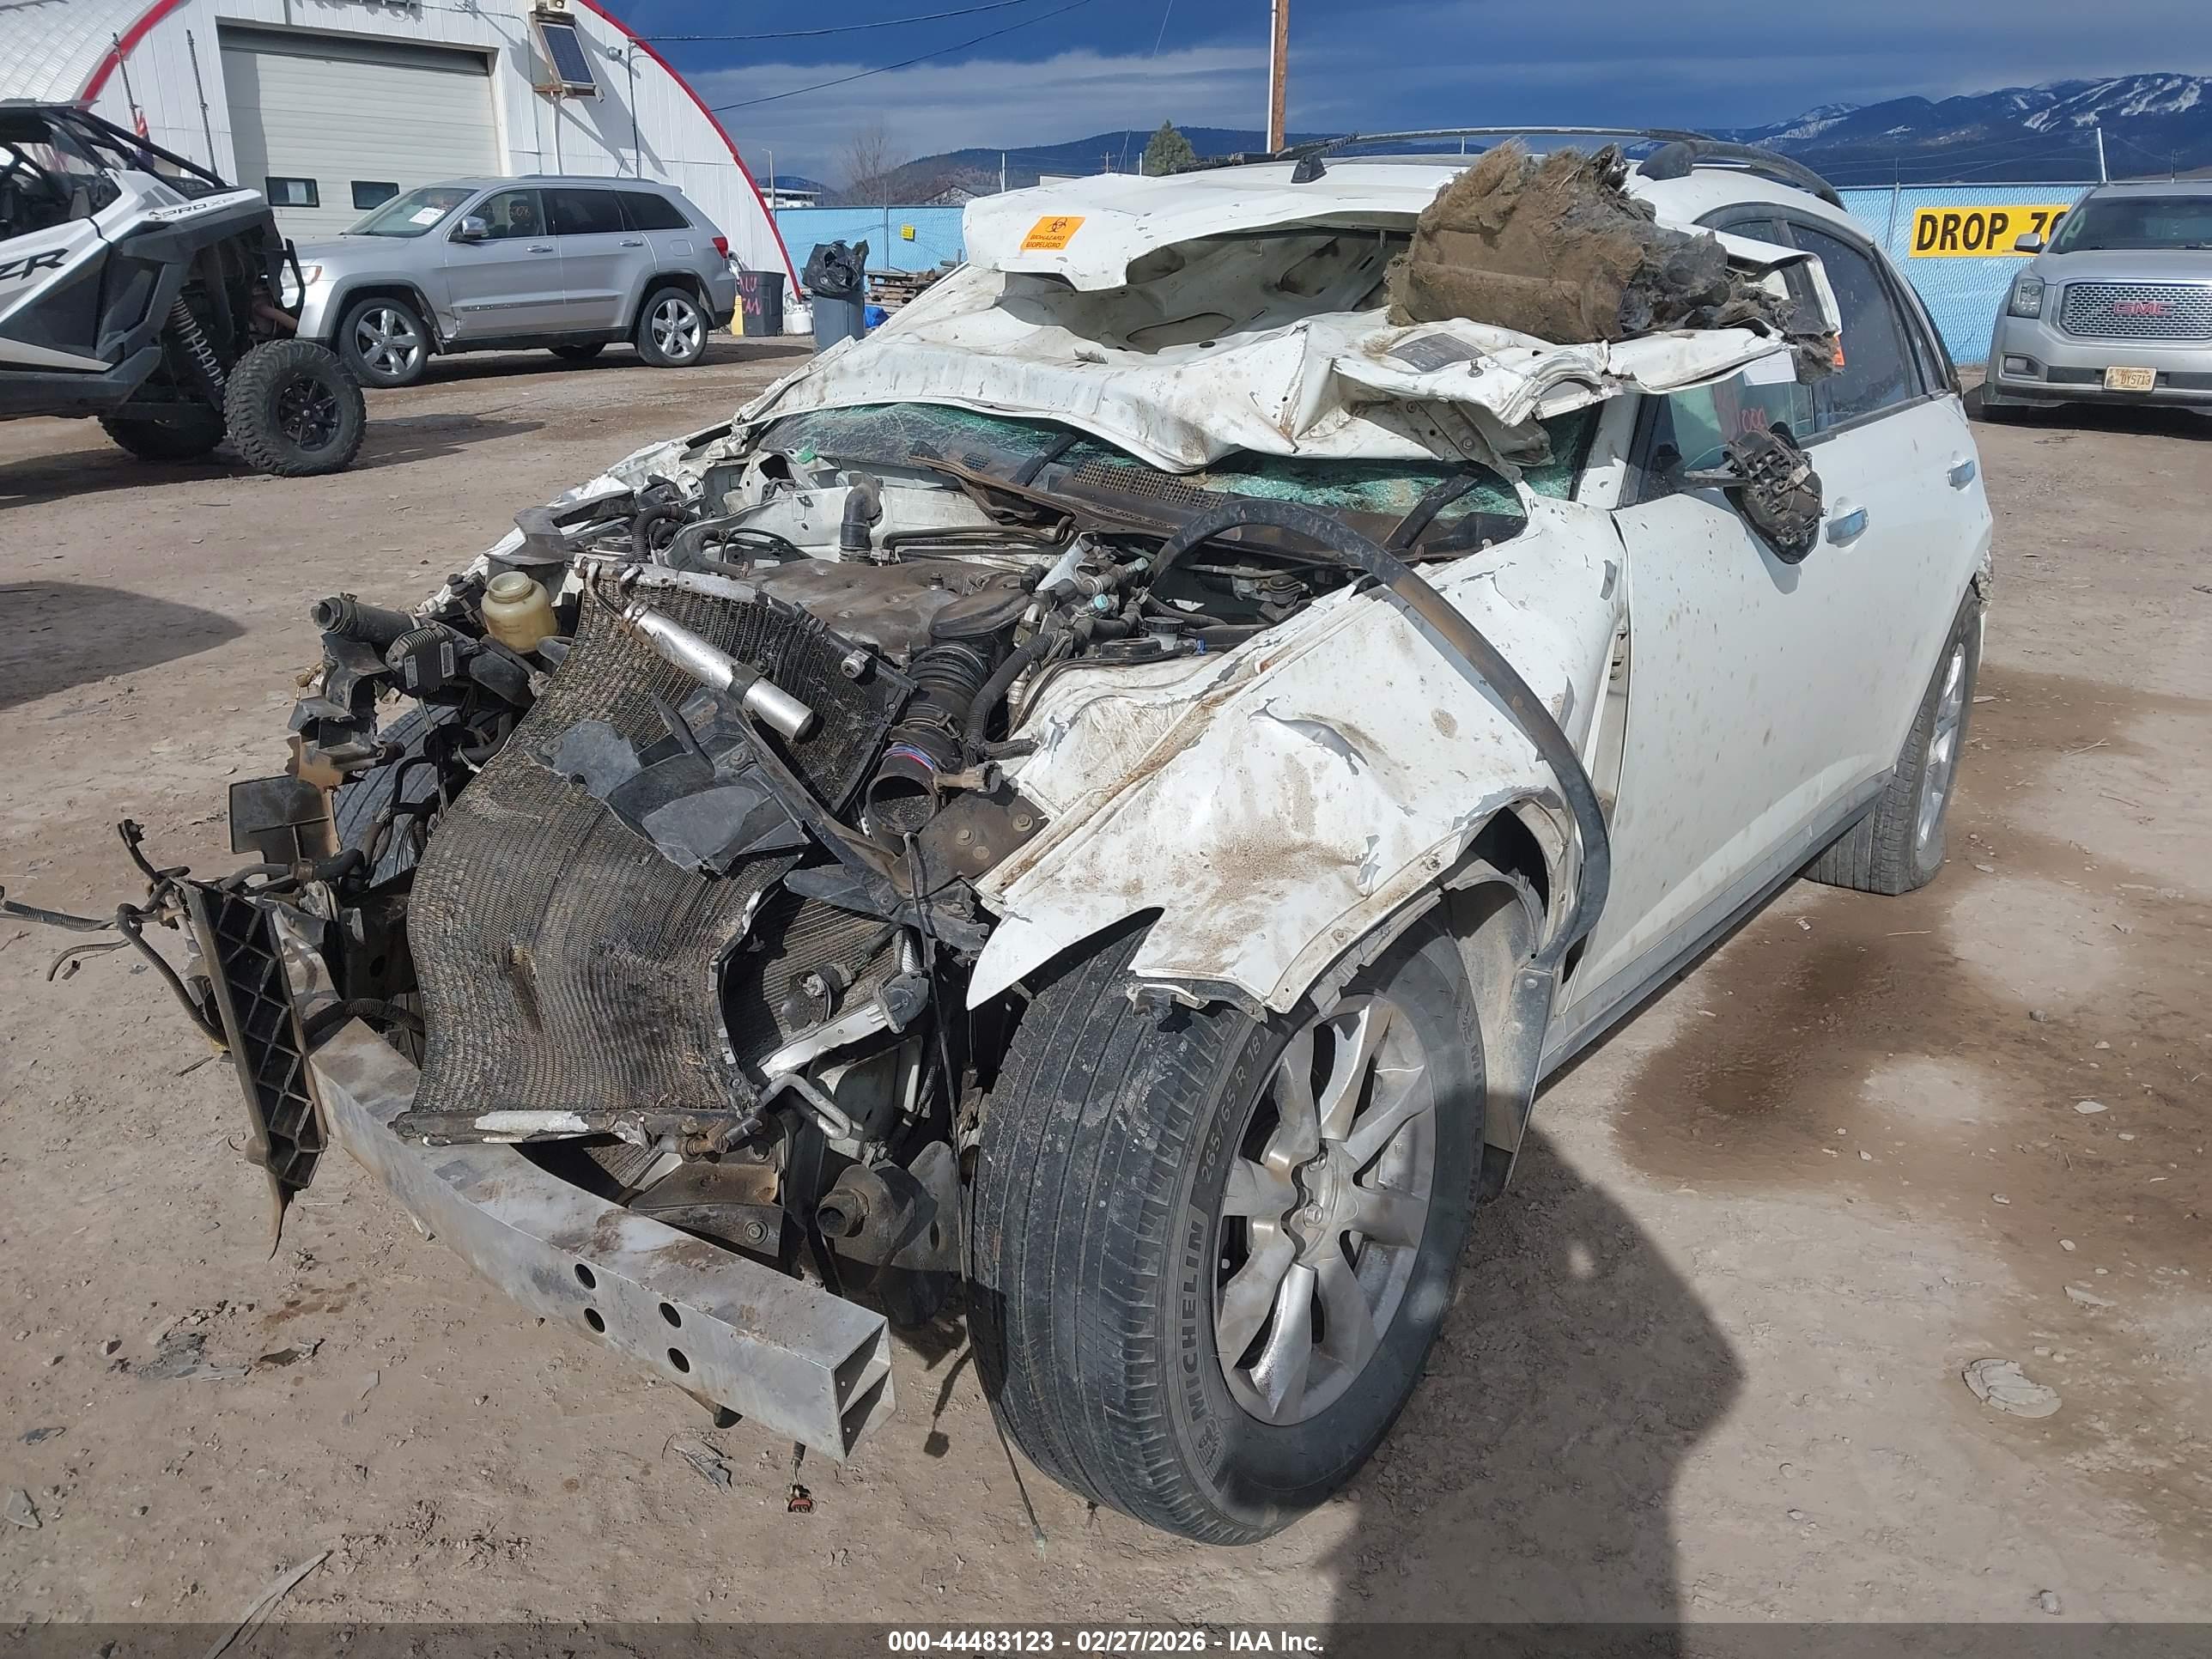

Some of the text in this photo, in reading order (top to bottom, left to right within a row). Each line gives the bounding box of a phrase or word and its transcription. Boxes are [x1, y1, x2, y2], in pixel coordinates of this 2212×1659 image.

[1916, 212, 2009, 251] DROP
[2114, 301, 2177, 316] GMC
[1202, 1036, 1261, 1182] 265/65 R 18
[1182, 1220, 1206, 1423] MICHELIN
